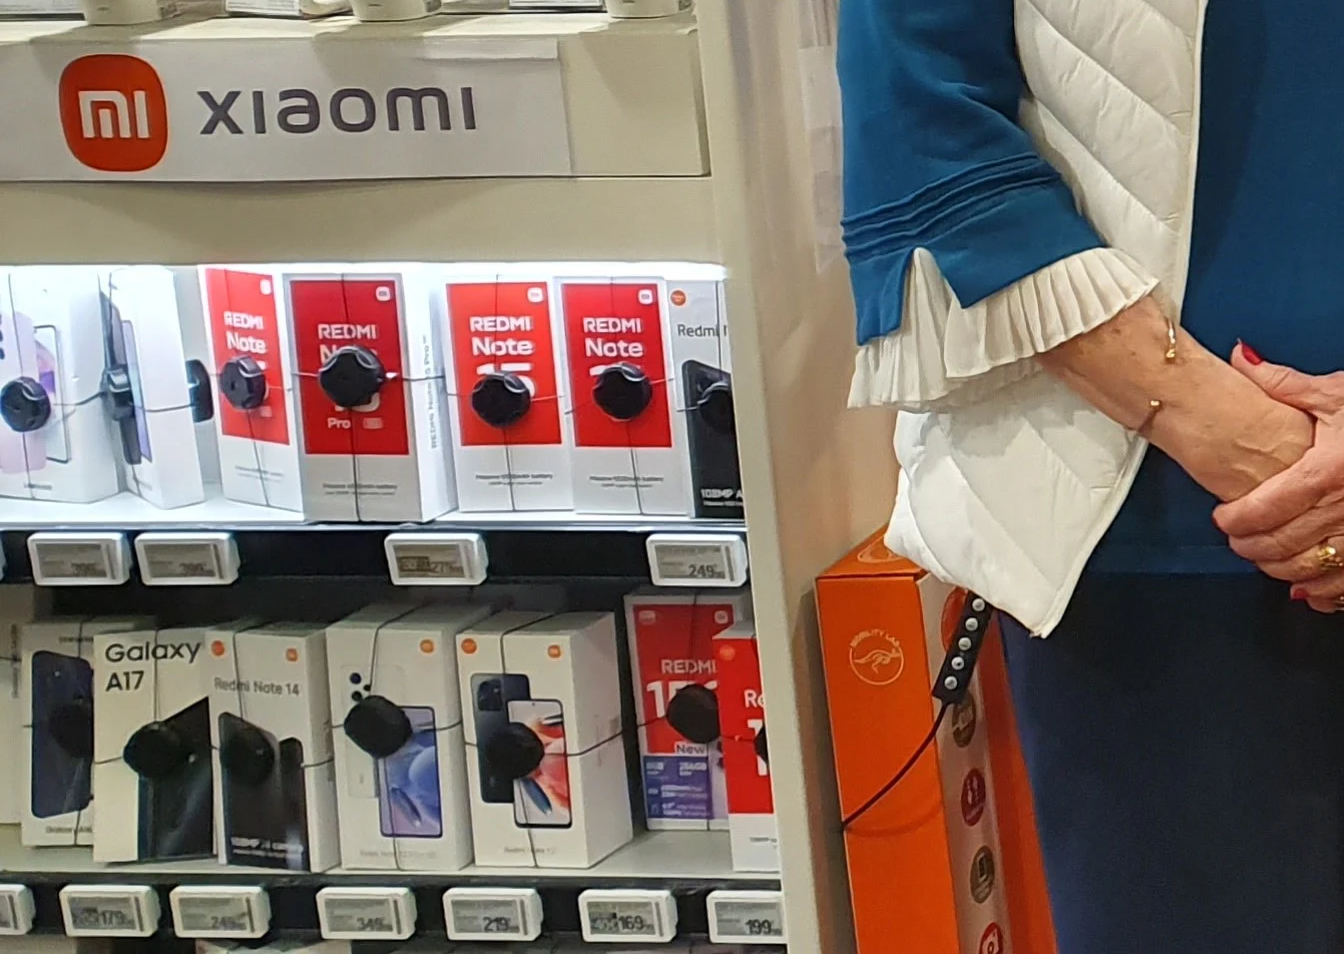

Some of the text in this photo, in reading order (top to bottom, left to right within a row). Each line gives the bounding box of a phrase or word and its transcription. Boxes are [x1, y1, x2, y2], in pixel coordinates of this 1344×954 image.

[197, 86, 477, 136] xiaomi
[223, 311, 265, 330] REDMI
[470, 316, 532, 333] REDMI
[583, 318, 642, 334] REDMI
[318, 324, 377, 341] REDMI
[226, 331, 267, 355] Note
[472, 338, 534, 357] Note
[586, 339, 644, 358] Note
[105, 642, 201, 664] Galaxy
[661, 659, 717, 674] REDMI
[105, 670, 144, 692] A17
[214, 677, 300, 696] Redmi Note 14
